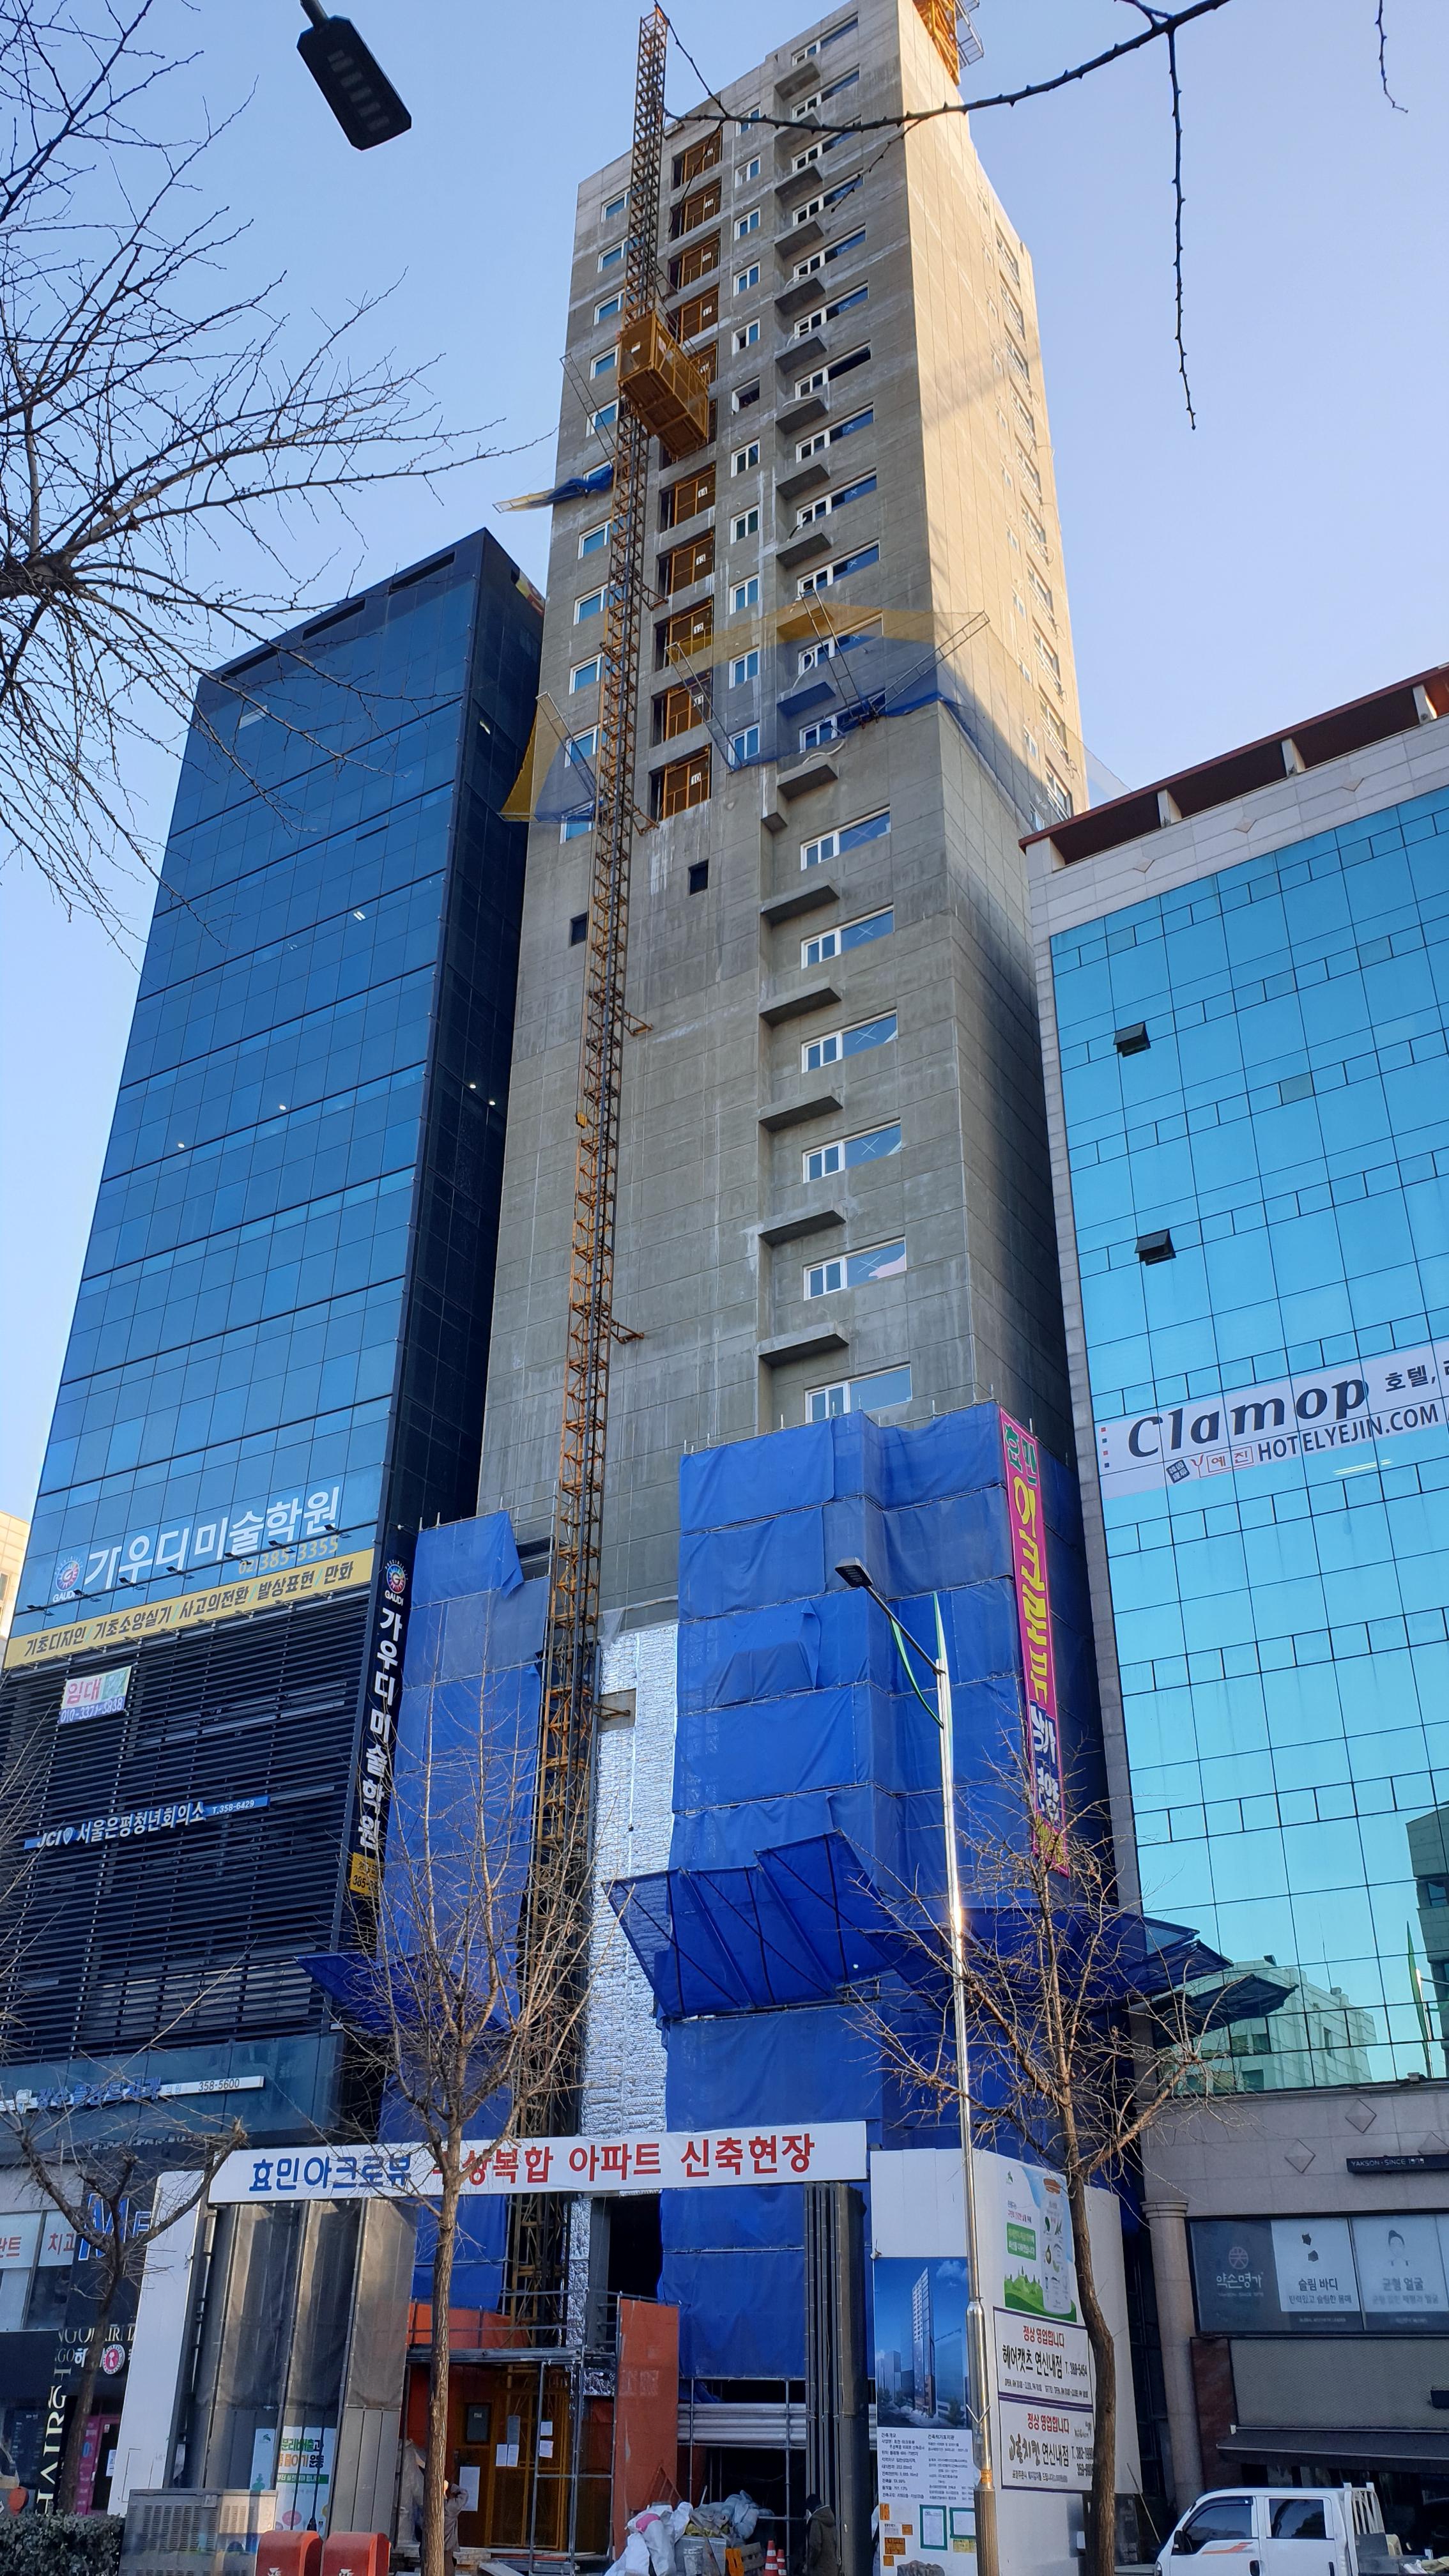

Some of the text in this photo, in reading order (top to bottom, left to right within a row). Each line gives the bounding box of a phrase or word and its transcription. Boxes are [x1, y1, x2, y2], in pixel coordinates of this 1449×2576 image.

[1128, 1365, 1436, 1458] Clamop 호텔,
[1257, 1404, 1439, 1462] HOTELYEJIN.COM
[1211, 1450, 1249, 1468] 예진
[84, 1486, 339, 1590] 가우디미술학원
[24, 1561, 354, 1657] 기초디자인 기초소양실기 사고의전환 발상표현 만화
[385, 1590, 404, 1606] GAUDI
[66, 1677, 102, 1705] 임대
[358, 1607, 402, 1850] 가우디미술학원
[37, 1830, 63, 1848] JCI
[77, 1802, 206, 1844] 서울은평청년회의소
[198, 2078, 240, 2092] 358-5600
[433, 2146, 554, 2186] 상복합
[569, 2143, 661, 2182] 아파트
[680, 2133, 815, 2177] 신축현장
[1216, 2272, 1262, 2289] 약손명가
[1298, 2278, 1338, 2292] 슬림 바디
[1404, 2278, 1424, 2291] 얼굴
[1023, 2325, 1064, 2348] 정상 영업합니다
[1002, 2344, 1033, 2373] 헤어캣츠
[1035, 2350, 1063, 2379] 연신내점
[1027, 2412, 1039, 2430] 정상
[1041, 2415, 1070, 2434] 영업합니다
[1042, 2442, 1069, 2467] 연신내점
